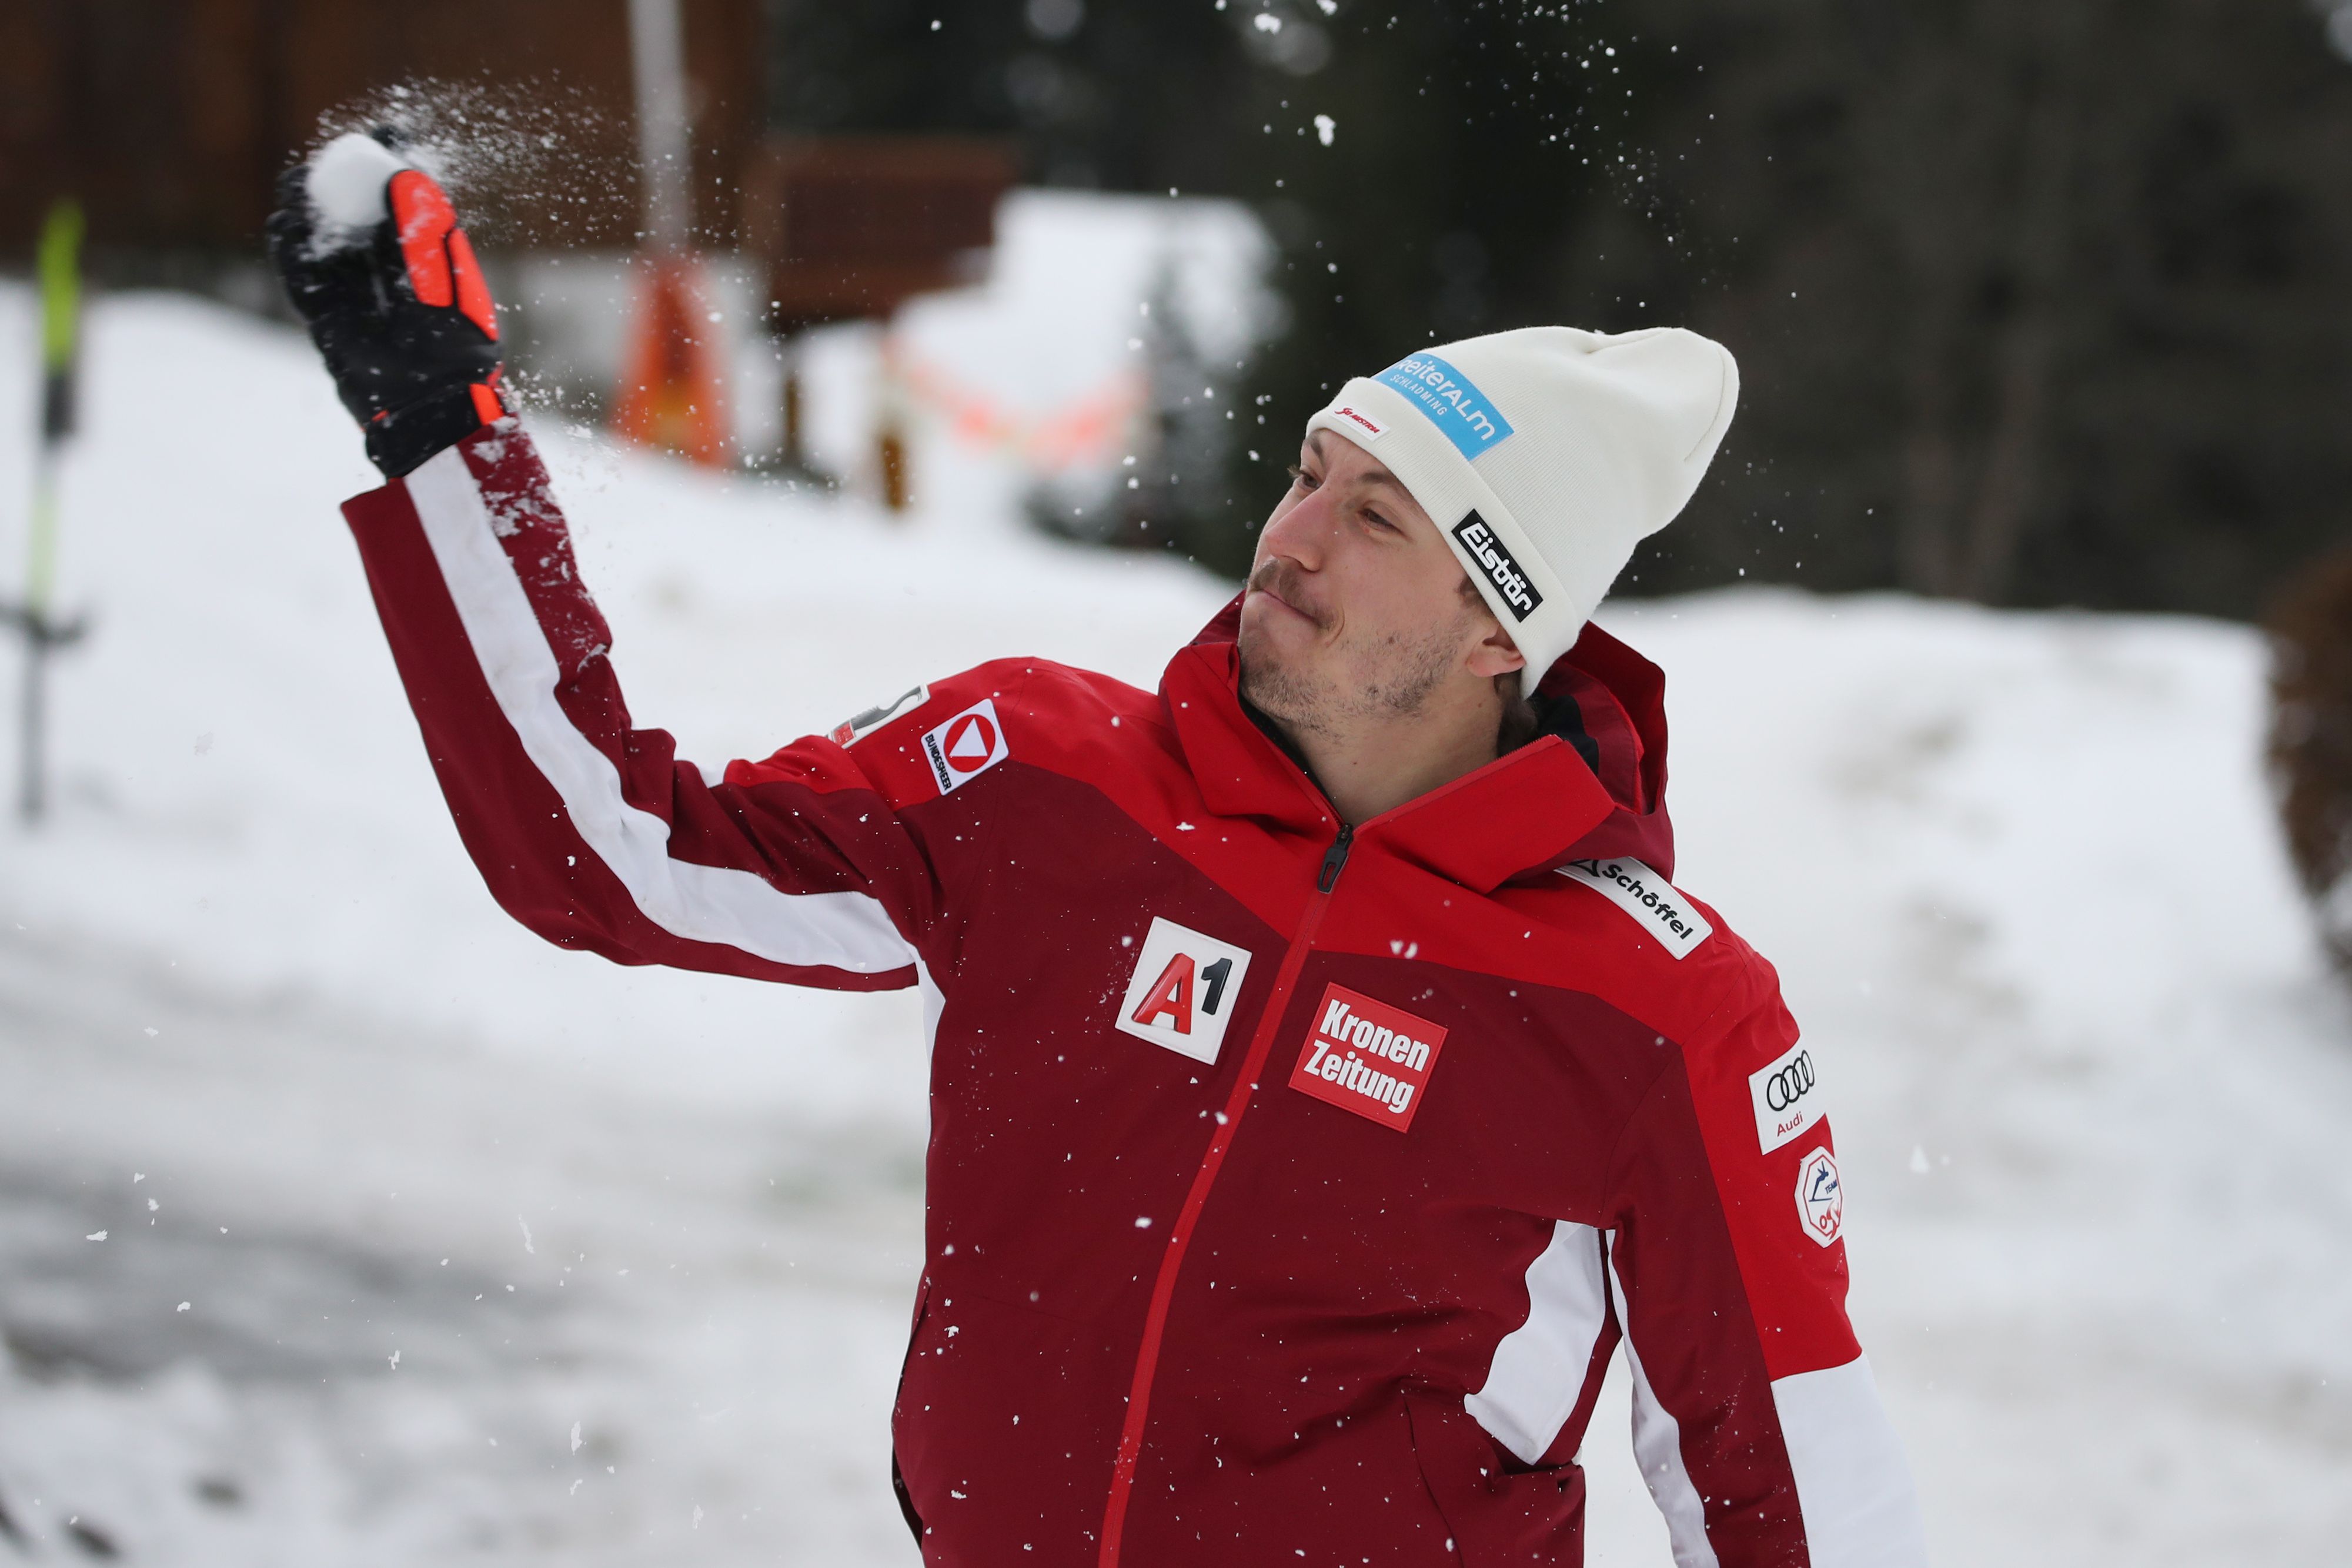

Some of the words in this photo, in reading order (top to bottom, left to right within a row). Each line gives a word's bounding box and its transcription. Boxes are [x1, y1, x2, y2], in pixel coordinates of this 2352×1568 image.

[1349, 414, 1380, 433] AUSTRIA
[1390, 374, 1447, 415] SCHLADMING
[1460, 522, 1532, 610] Eisbär
[925, 733, 952, 791] BUNDESHEER
[1602, 864, 1693, 940] Schöffel
[1131, 952, 1232, 1035] A1
[1319, 999, 1430, 1072] Kronen
[1304, 1039, 1415, 1114] Zeitung
[1777, 1111, 1803, 1137] Audi
[1825, 1179, 1838, 1195] TEAM
